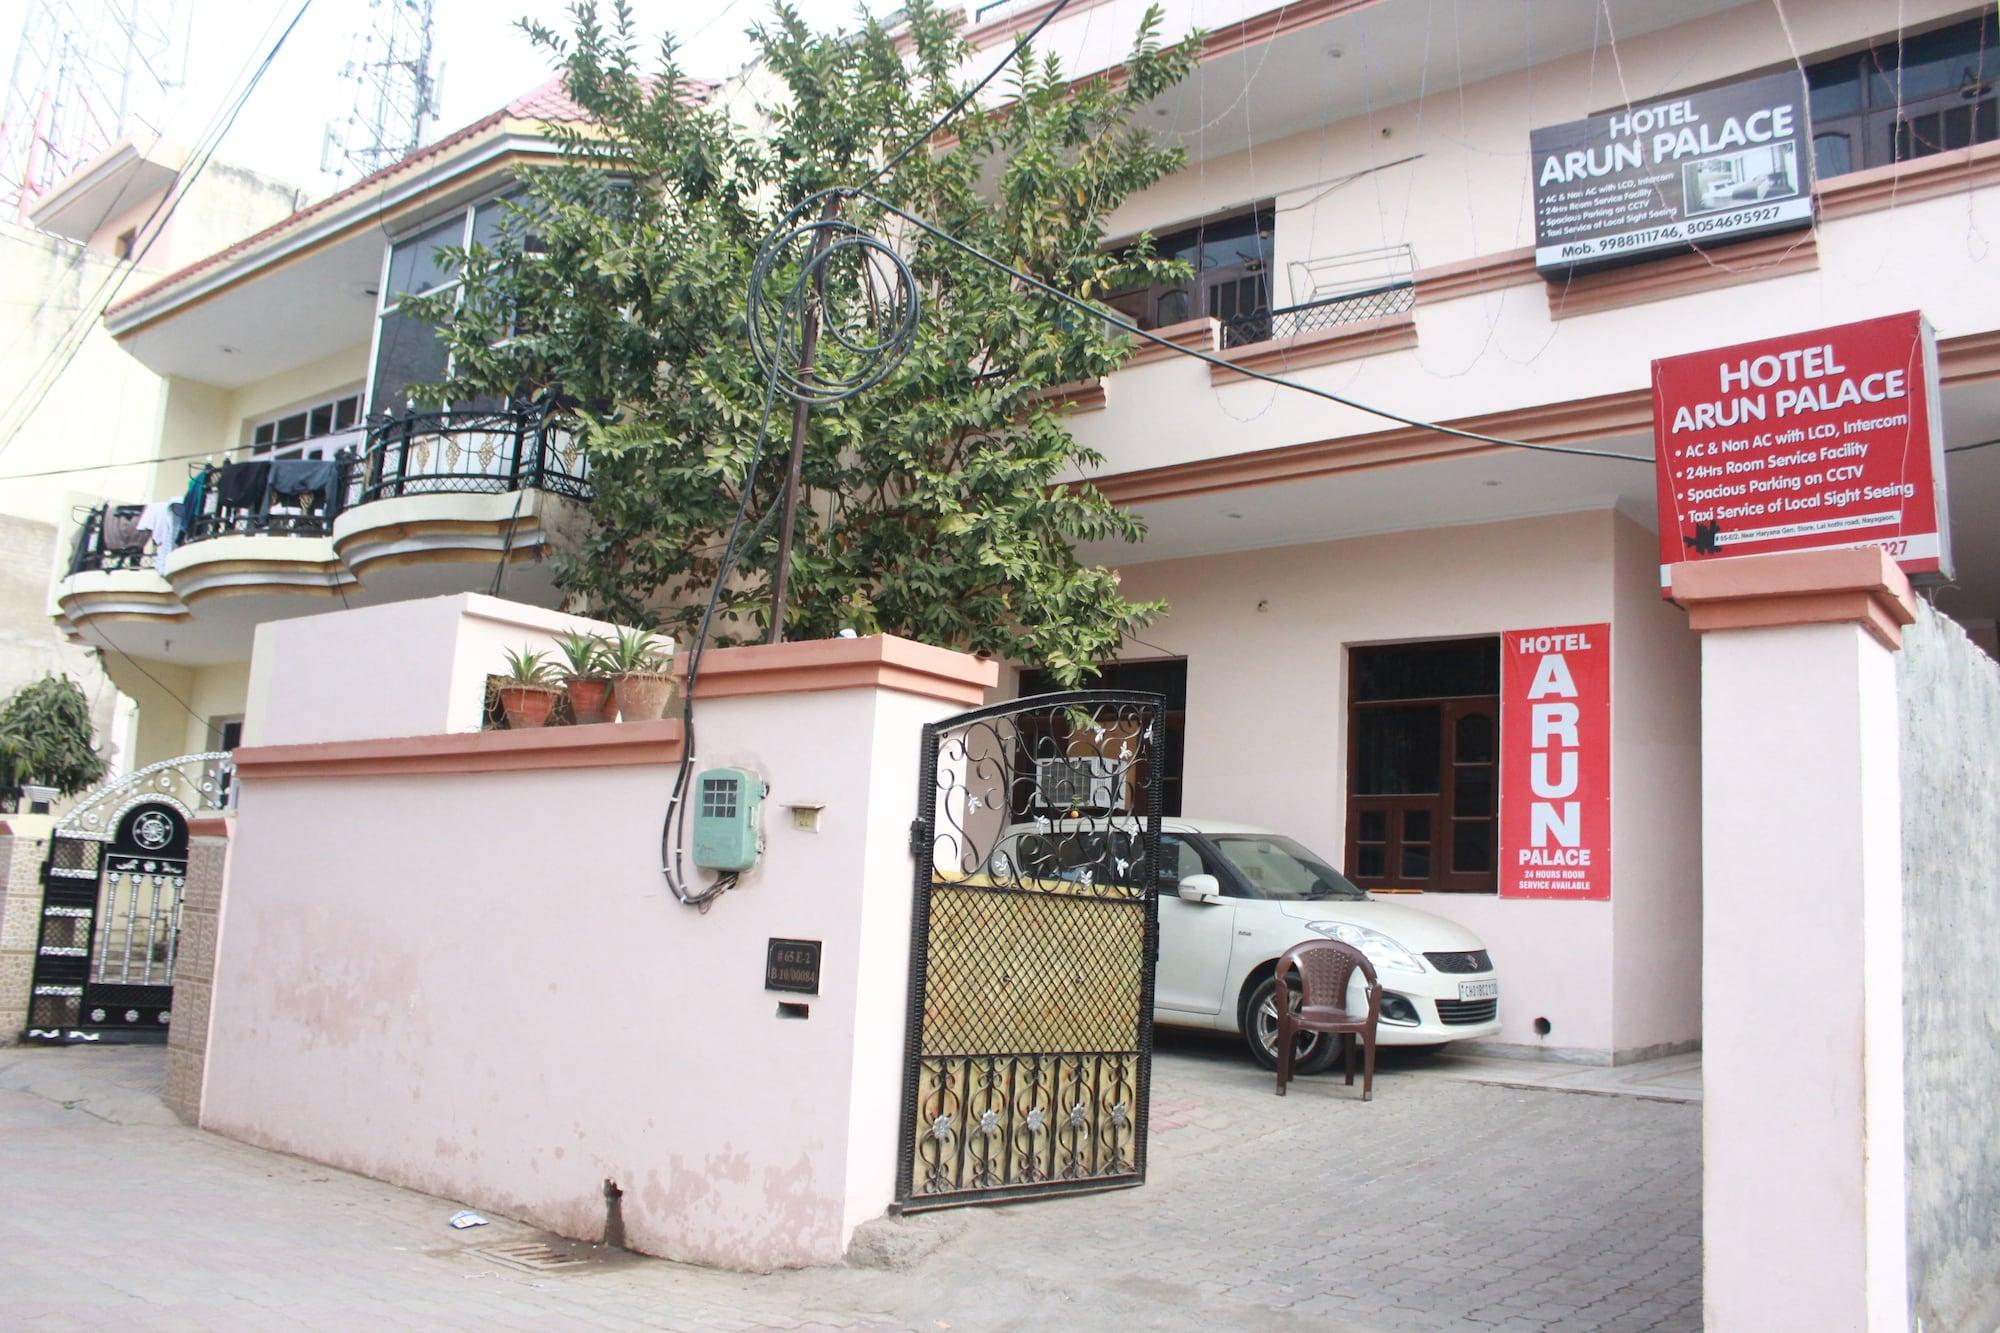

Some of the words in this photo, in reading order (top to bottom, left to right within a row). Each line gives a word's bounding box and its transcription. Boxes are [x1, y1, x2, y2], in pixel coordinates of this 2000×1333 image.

[1609, 100, 1700, 139] HOTEL
[1539, 139, 1642, 187] ARUN
[1653, 105, 1794, 164] PALACE
[1545, 194, 1557, 203] AC
[1558, 193, 1566, 202] &
[1567, 191, 1583, 199] Non
[1585, 187, 1597, 196] AC
[1599, 183, 1616, 194] with
[1617, 180, 1636, 190] LCD,
[1569, 200, 1593, 211] Room
[1594, 194, 1623, 206] Service
[1624, 189, 1652, 201] Facility
[1546, 215, 1582, 228] Spacious
[1583, 207, 1613, 220] Parking
[1615, 204, 1626, 213] on
[1628, 199, 1650, 210] CCTV
[1561, 242, 1595, 258] Mob.
[1599, 227, 1682, 252] 9988111746,
[1687, 207, 1780, 235] 8054695927
[1564, 221, 1592, 235] Service
[1593, 219, 1602, 229] of
[1603, 216, 1625, 228] Local
[1626, 210, 1647, 223] Sight
[1649, 206, 1677, 219] Seeing
[1719, 344, 1846, 393] HOTEL
[1671, 394, 1766, 434] ARUN
[1776, 369, 1906, 418] PALACE
[1685, 444, 1704, 459] AC
[1707, 442, 1719, 455] &
[1721, 439, 1749, 453] Non
[1752, 434, 1772, 449] AC
[1775, 428, 1804, 445] with
[1808, 423, 1840, 440] LCD,
[1844, 414, 1908, 434] Intercom
[1686, 466, 1723, 480] 24Hrs
[1726, 460, 1764, 474] Room
[1767, 450, 1817, 469] Service
[1820, 442, 1868, 461] Facility
[1687, 484, 1746, 504] Spacious
[1749, 476, 1802, 493] Parking
[1804, 472, 1823, 485] on
[1826, 465, 1864, 482] CCTV
[1687, 507, 1714, 523] Taxi
[1716, 502, 1764, 520] Service
[1767, 498, 1782, 513] of
[1784, 493, 1821, 511] Local
[1823, 487, 1861, 507] Sight
[1863, 482, 1914, 501] Seeing
[1520, 633, 1592, 654] HOTEL
[1527, 653, 1581, 848] ARUN
[1519, 848, 1591, 866] PALACE
[1524, 870, 1534, 879] 24
[1535, 870, 1560, 879] HOURS
[1562, 870, 1585, 879] ROOM
[1519, 880, 1550, 890] SERVICE
[1551, 881, 1591, 890] AVAILABLE
